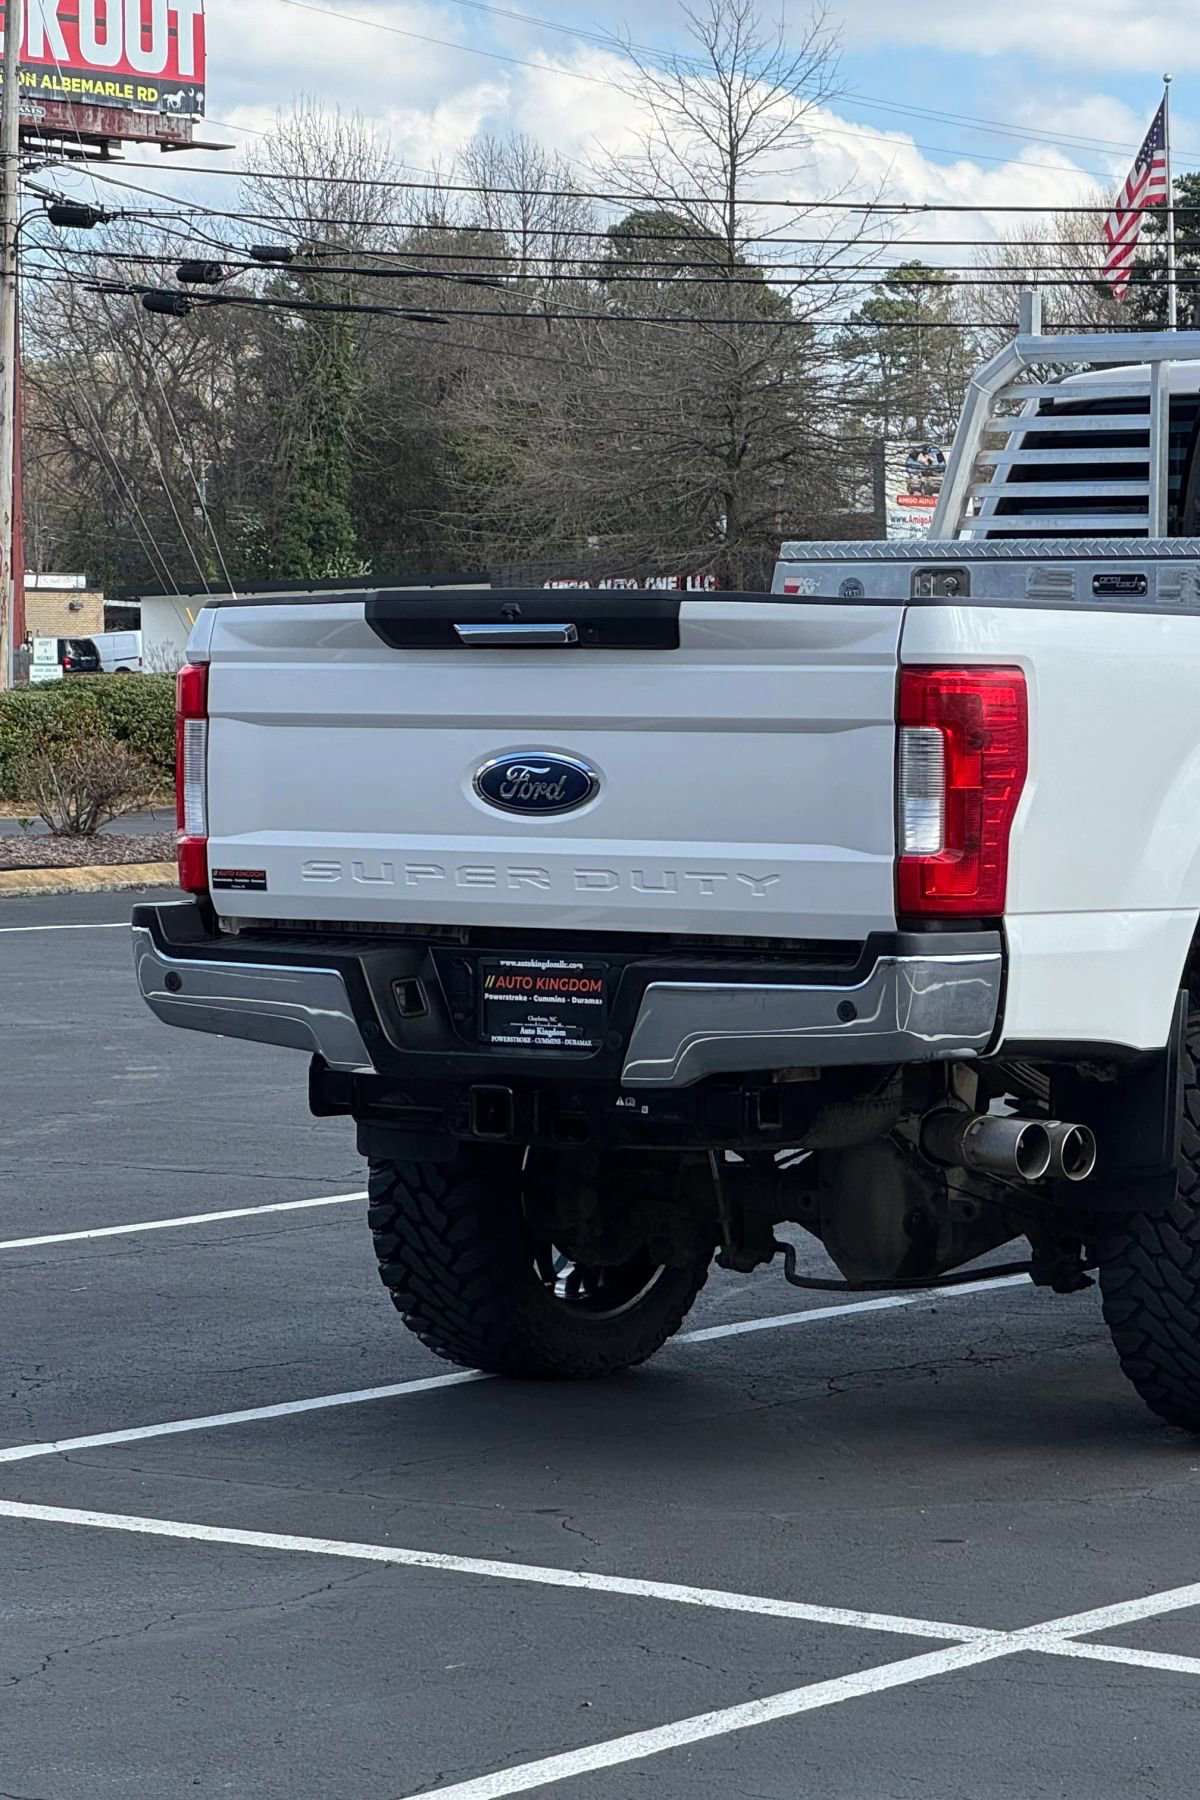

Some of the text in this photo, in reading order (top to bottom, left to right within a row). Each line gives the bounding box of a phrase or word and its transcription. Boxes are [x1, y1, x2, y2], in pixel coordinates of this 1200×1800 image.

[41, 74, 134, 100] ALBEMARLE
[137, 86, 158, 103] RD
[499, 764, 567, 801] Ford
[302, 859, 781, 896] SUPER DUTY
[535, 977, 603, 992] KINGDOM
[484, 992, 528, 1002] Powerstroke
[533, 994, 566, 1004] Cummins
[519, 1027, 567, 1038] Auto Kingdom
[490, 1035, 532, 1044] POWERSTROKE
[534, 1037, 562, 1045] CUMMINS
[564, 1039, 593, 1047] DURAMAX
